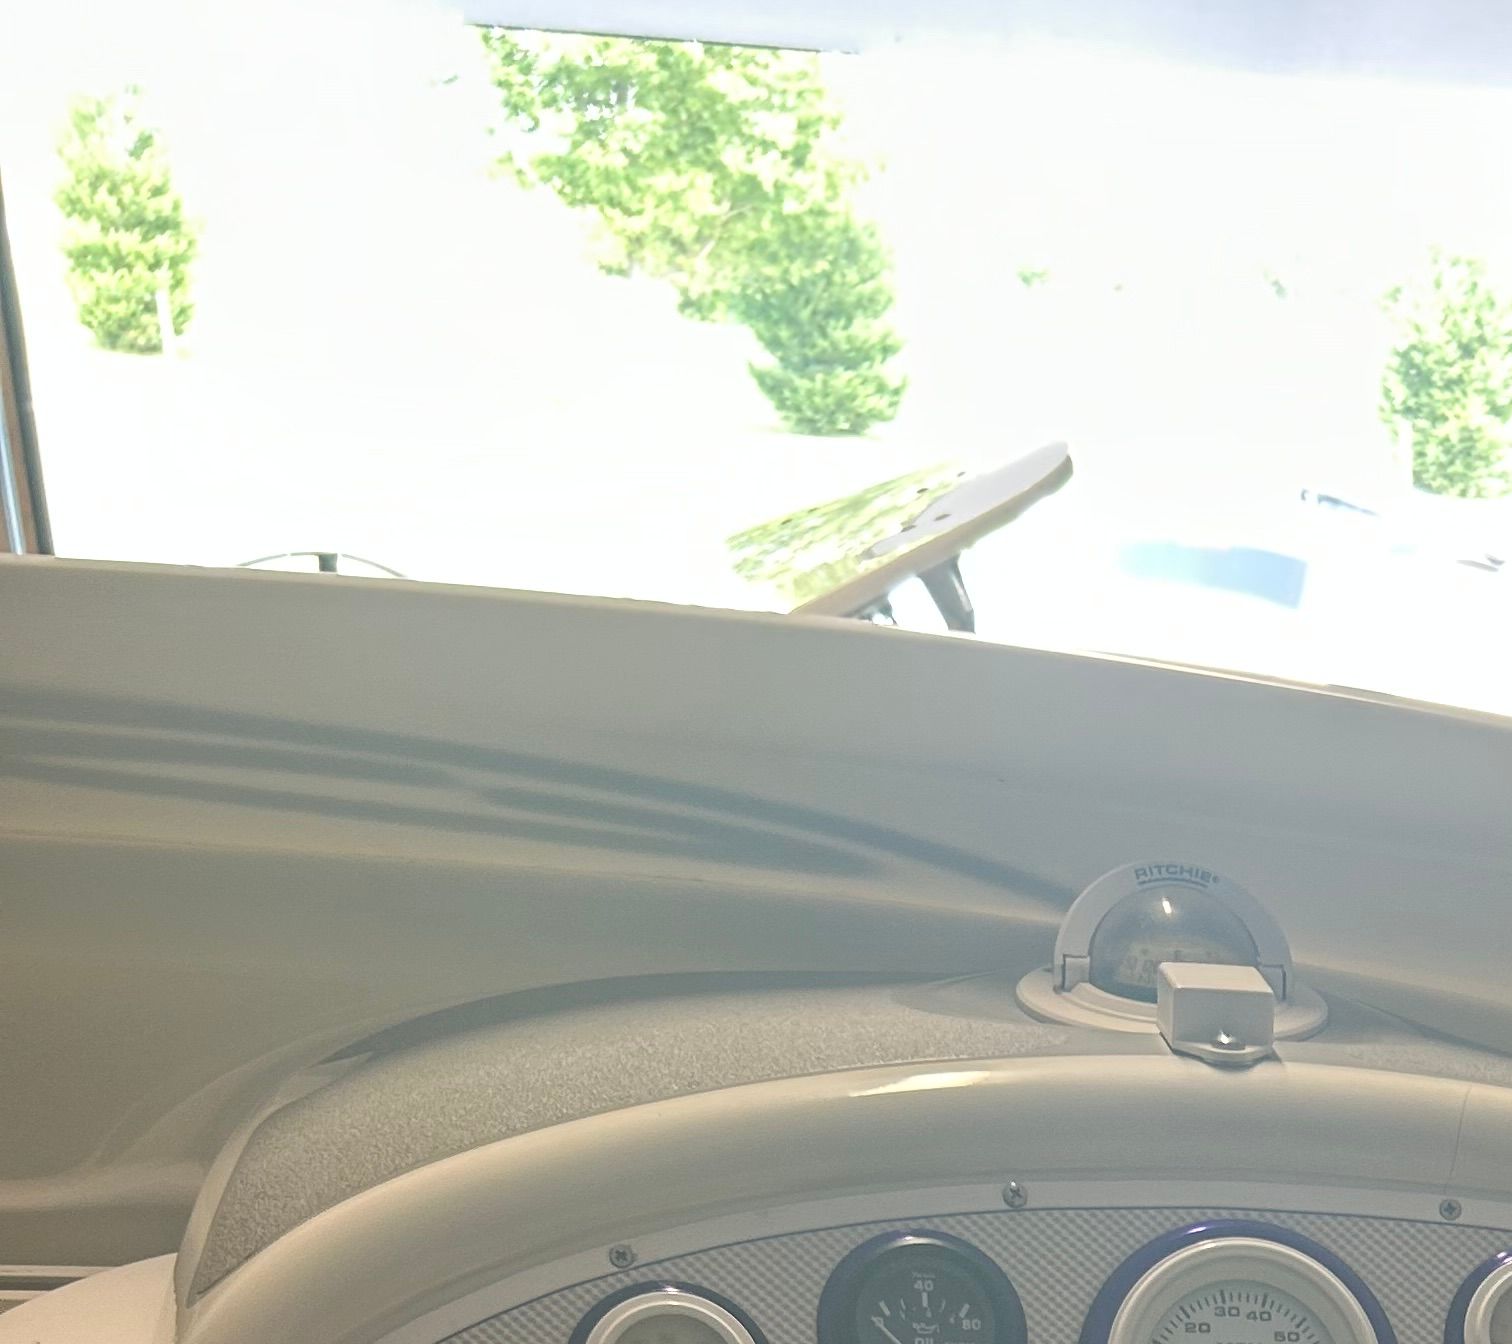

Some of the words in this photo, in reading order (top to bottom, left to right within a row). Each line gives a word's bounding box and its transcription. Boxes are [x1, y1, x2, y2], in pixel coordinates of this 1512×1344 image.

[913, 1280, 934, 1291] 40
[1214, 1306, 1240, 1317] 30
[1246, 1311, 1272, 1322] 40
[1184, 1322, 1211, 1334] 20
[1274, 1331, 1300, 1342] 50
